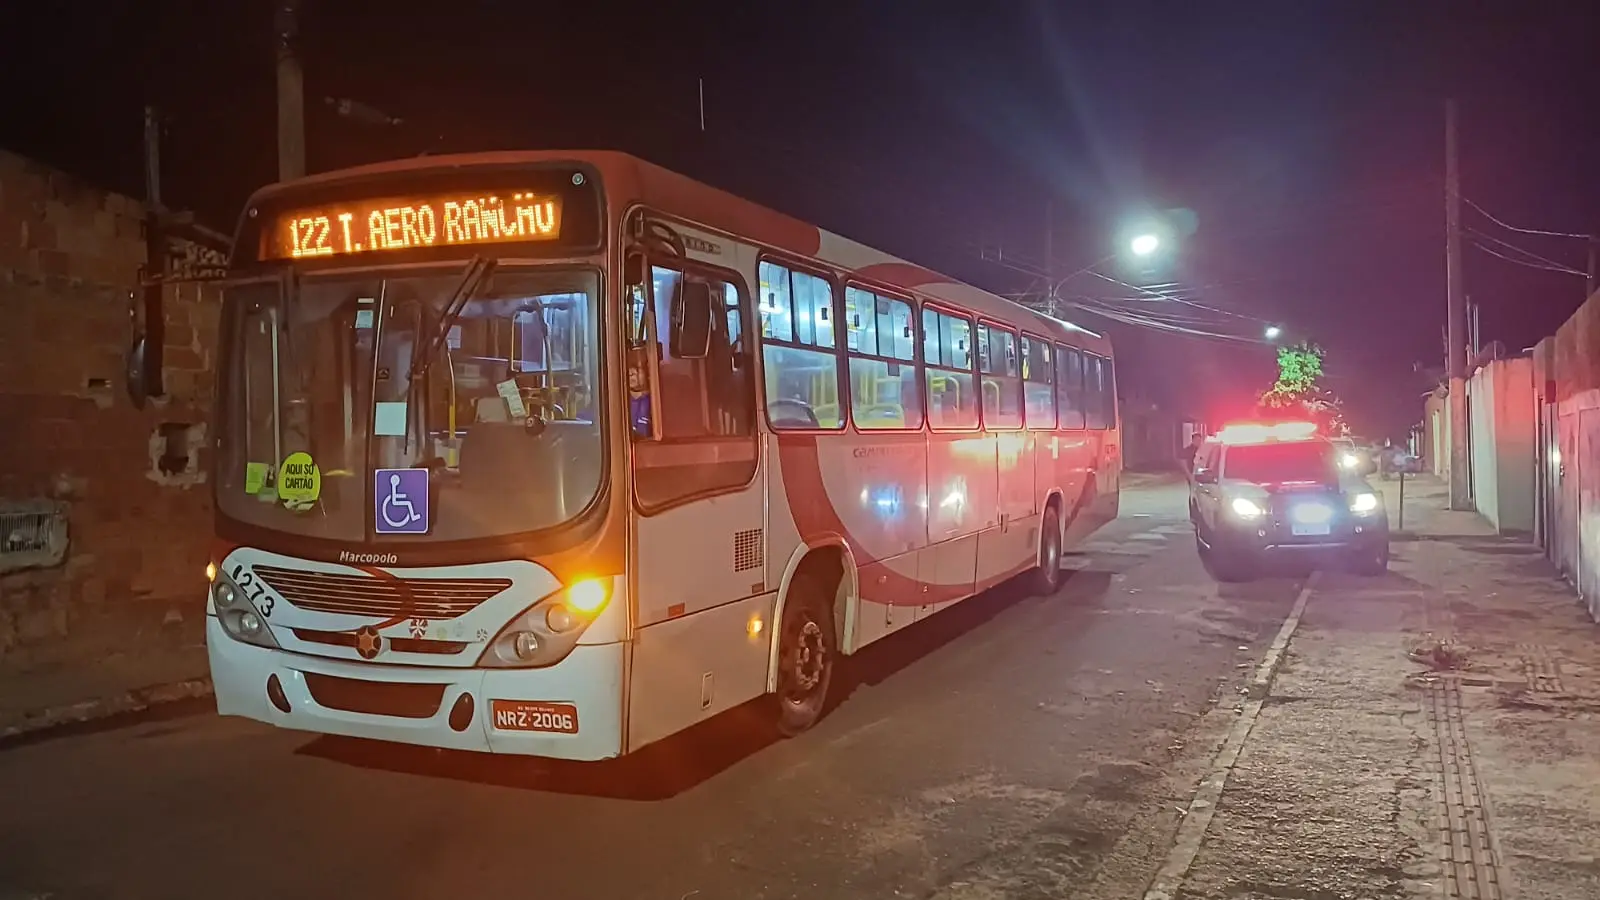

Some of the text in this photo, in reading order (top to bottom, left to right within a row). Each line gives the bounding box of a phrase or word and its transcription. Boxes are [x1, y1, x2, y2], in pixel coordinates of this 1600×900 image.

[289, 216, 332, 257] 122
[368, 204, 436, 250] AERO
[285, 463, 303, 475] AQUI
[339, 550, 398, 564] Marcopolo
[232, 564, 275, 618] 1273
